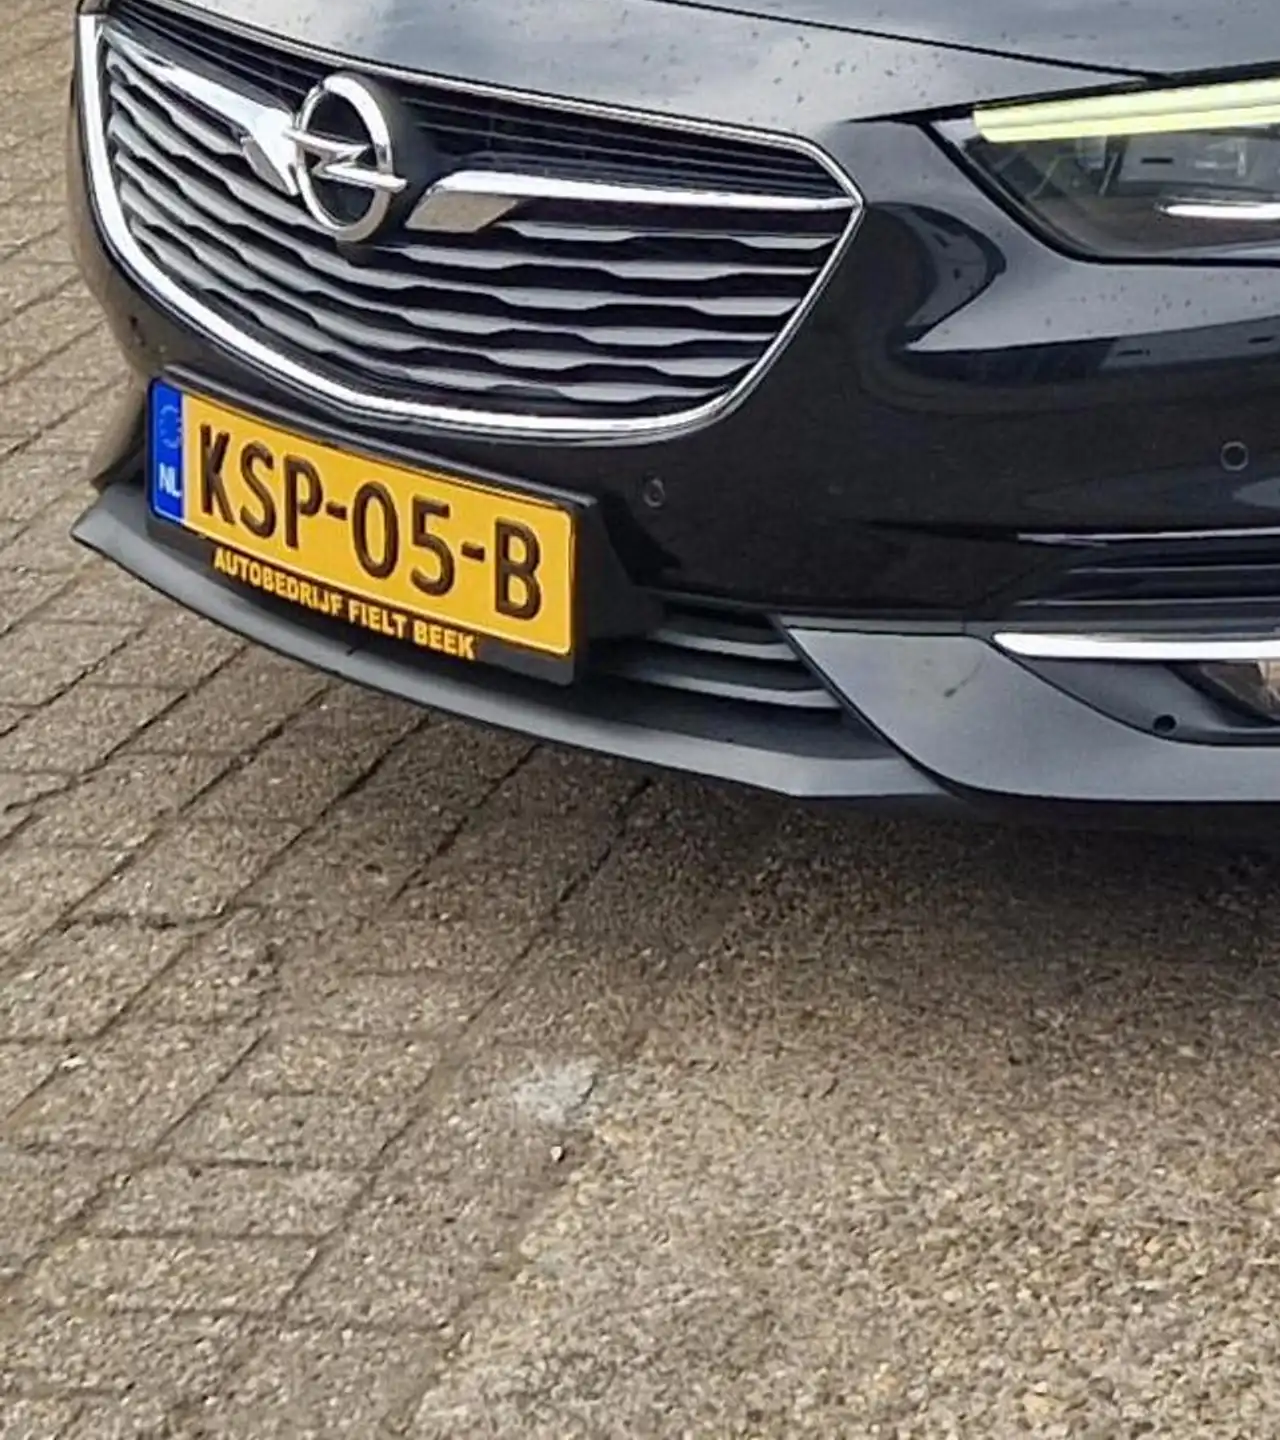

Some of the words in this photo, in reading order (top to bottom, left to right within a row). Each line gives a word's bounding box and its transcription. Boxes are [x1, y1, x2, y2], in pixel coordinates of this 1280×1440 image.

[158, 461, 182, 498] NL
[200, 423, 541, 621] KSP-05-B
[214, 547, 344, 617] AUTOBEDRIJF
[348, 600, 406, 637] FIELT
[414, 621, 476, 660] BEEK
